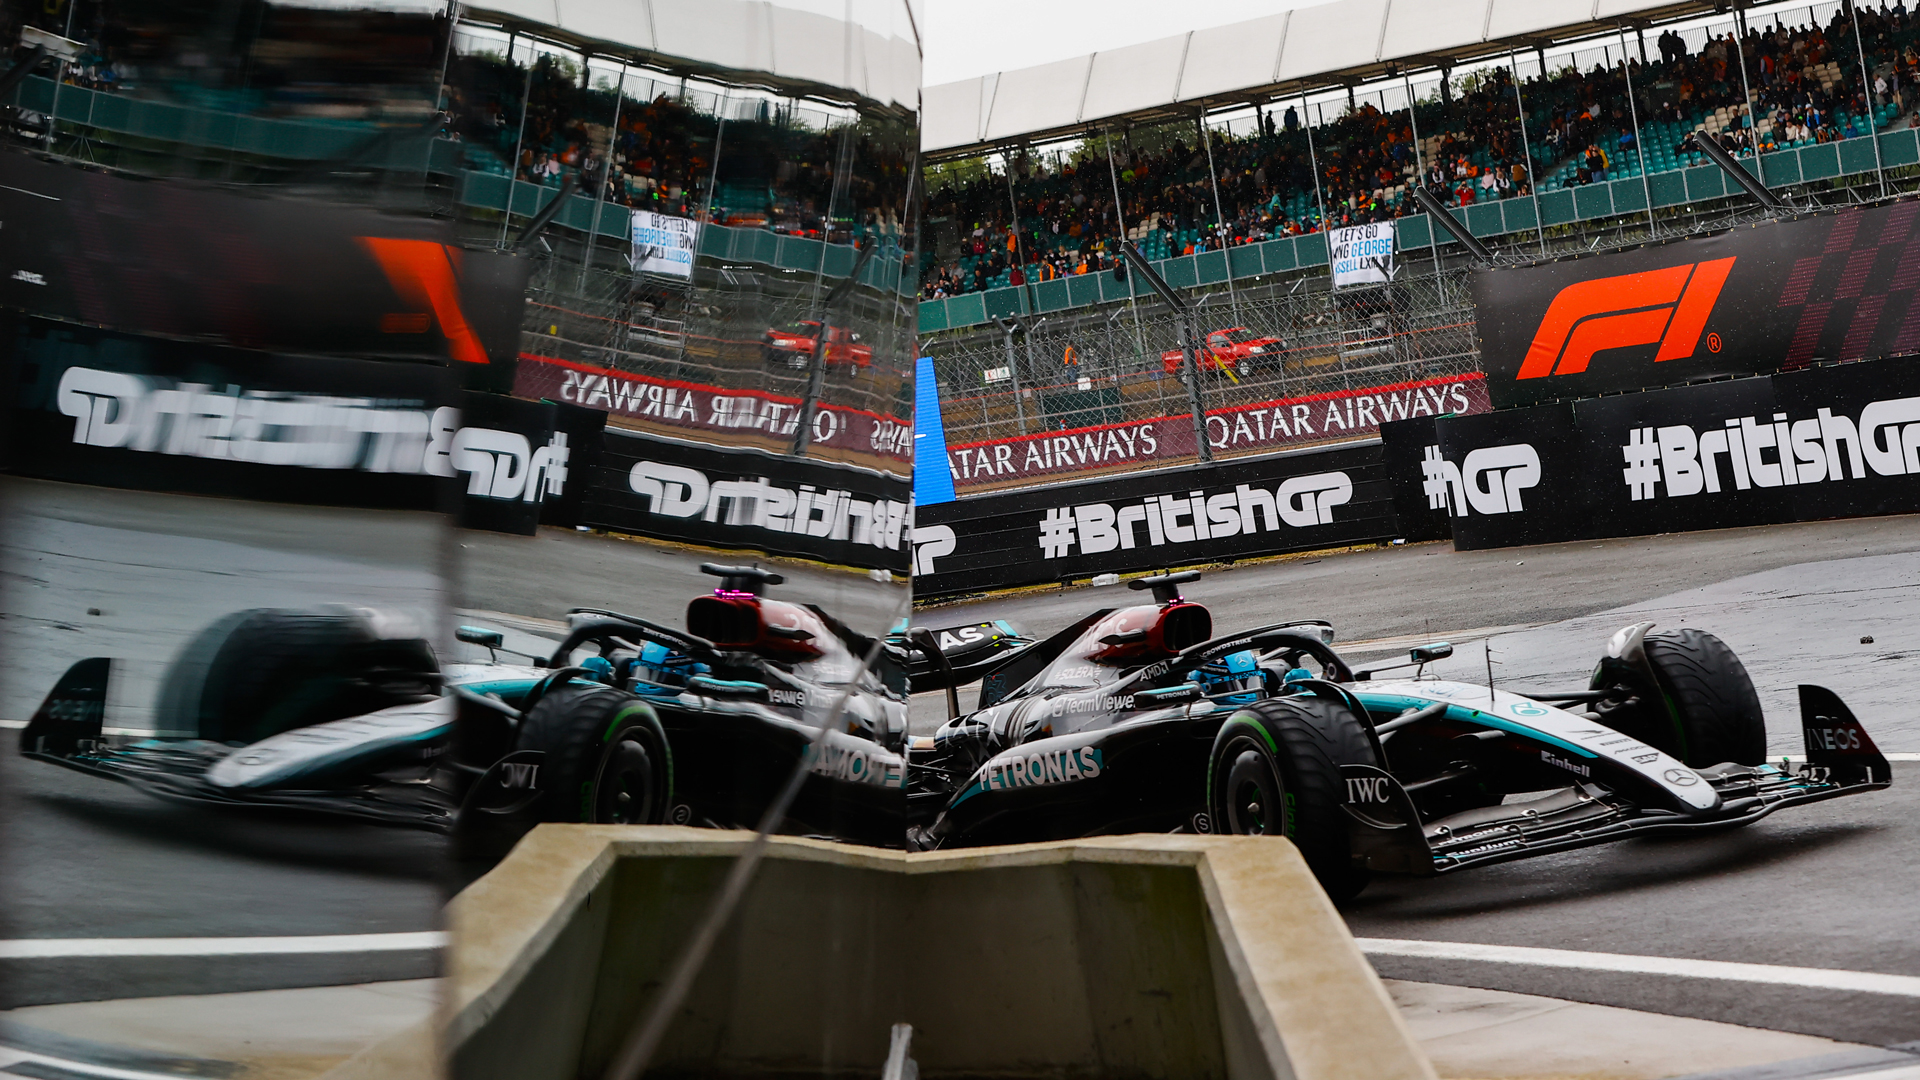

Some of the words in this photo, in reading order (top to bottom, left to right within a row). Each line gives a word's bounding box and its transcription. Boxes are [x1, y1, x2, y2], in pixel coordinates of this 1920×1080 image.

[1340, 226, 1364, 243] LET'S
[1366, 224, 1378, 239] GO
[1351, 238, 1392, 258] GEORGE
[1208, 403, 1315, 449] QATAR
[1324, 383, 1470, 432] AIRWAYS
[948, 443, 1017, 481] ATAR
[1024, 425, 1157, 471] AIRWAYS
[1038, 471, 1353, 559] #BritishGP
[1202, 637, 1253, 657] CROWDSTRIKE
[1065, 693, 1136, 713] TeamViewe
[1156, 689, 1191, 700] PETRONAS
[1806, 728, 1861, 751] INEOS
[980, 746, 1100, 790] PETRONAS
[1541, 749, 1590, 778] Einhell
[1345, 777, 1390, 803] IWC
